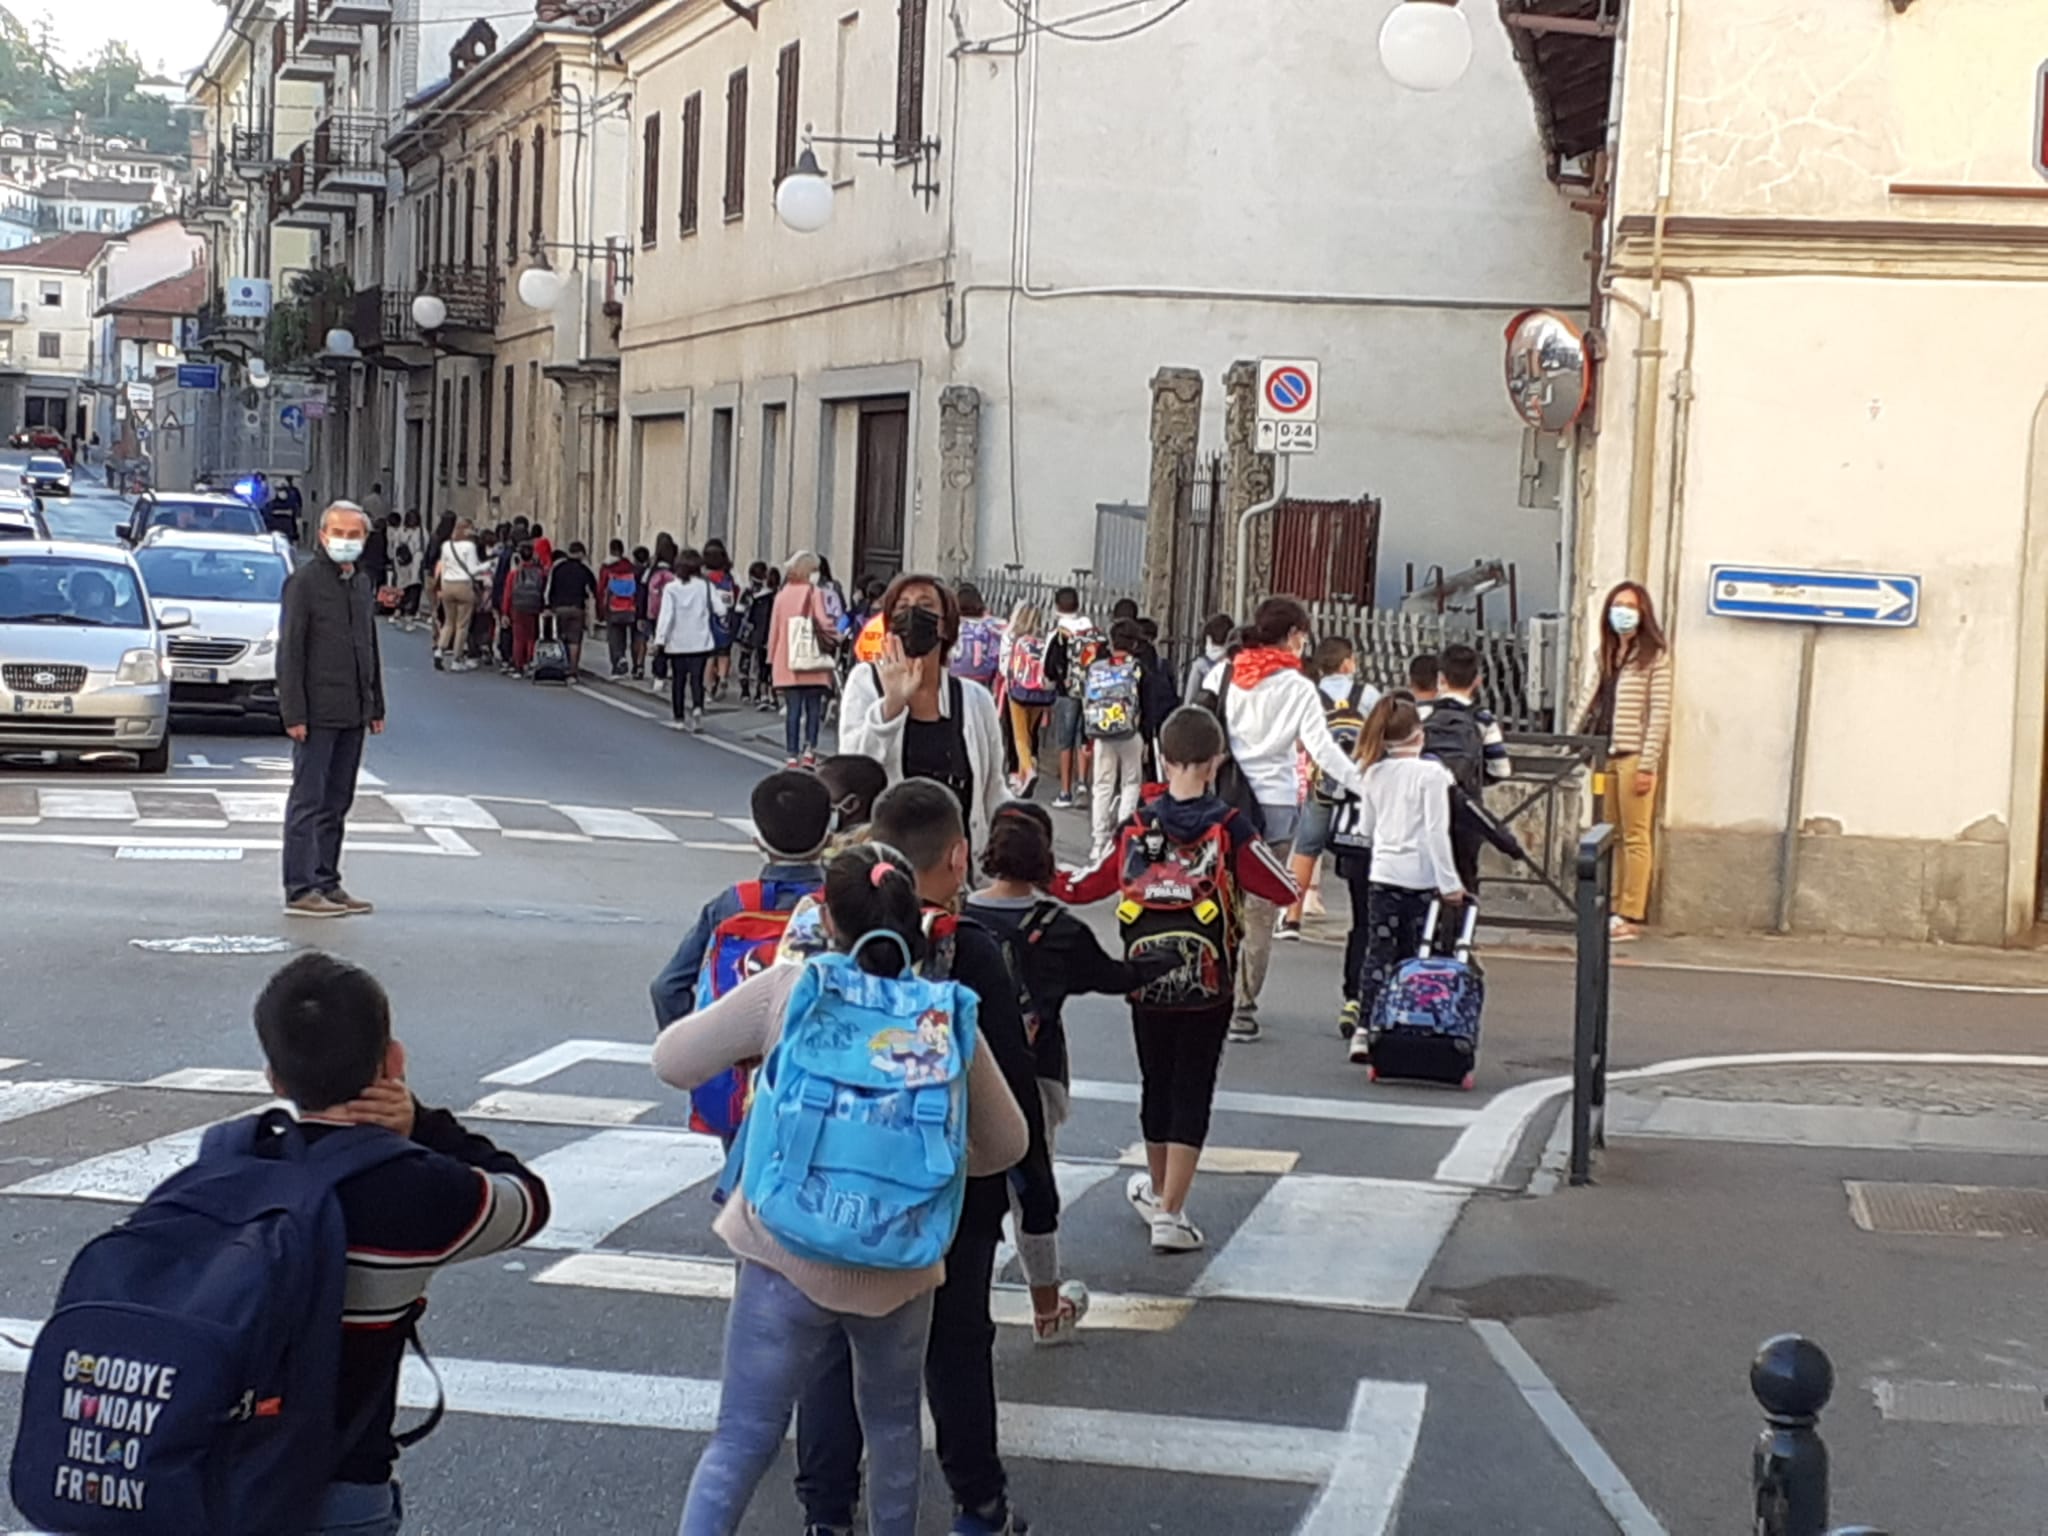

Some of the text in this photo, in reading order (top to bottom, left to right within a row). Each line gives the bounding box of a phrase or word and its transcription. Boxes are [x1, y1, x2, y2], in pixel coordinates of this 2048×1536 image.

[1281, 424, 1312, 436] 0-24
[64, 1350, 176, 1399] GODBYE
[62, 1387, 162, 1435] MNDAY
[67, 1426, 140, 1470] HELO
[55, 1466, 144, 1510] FRDAY
